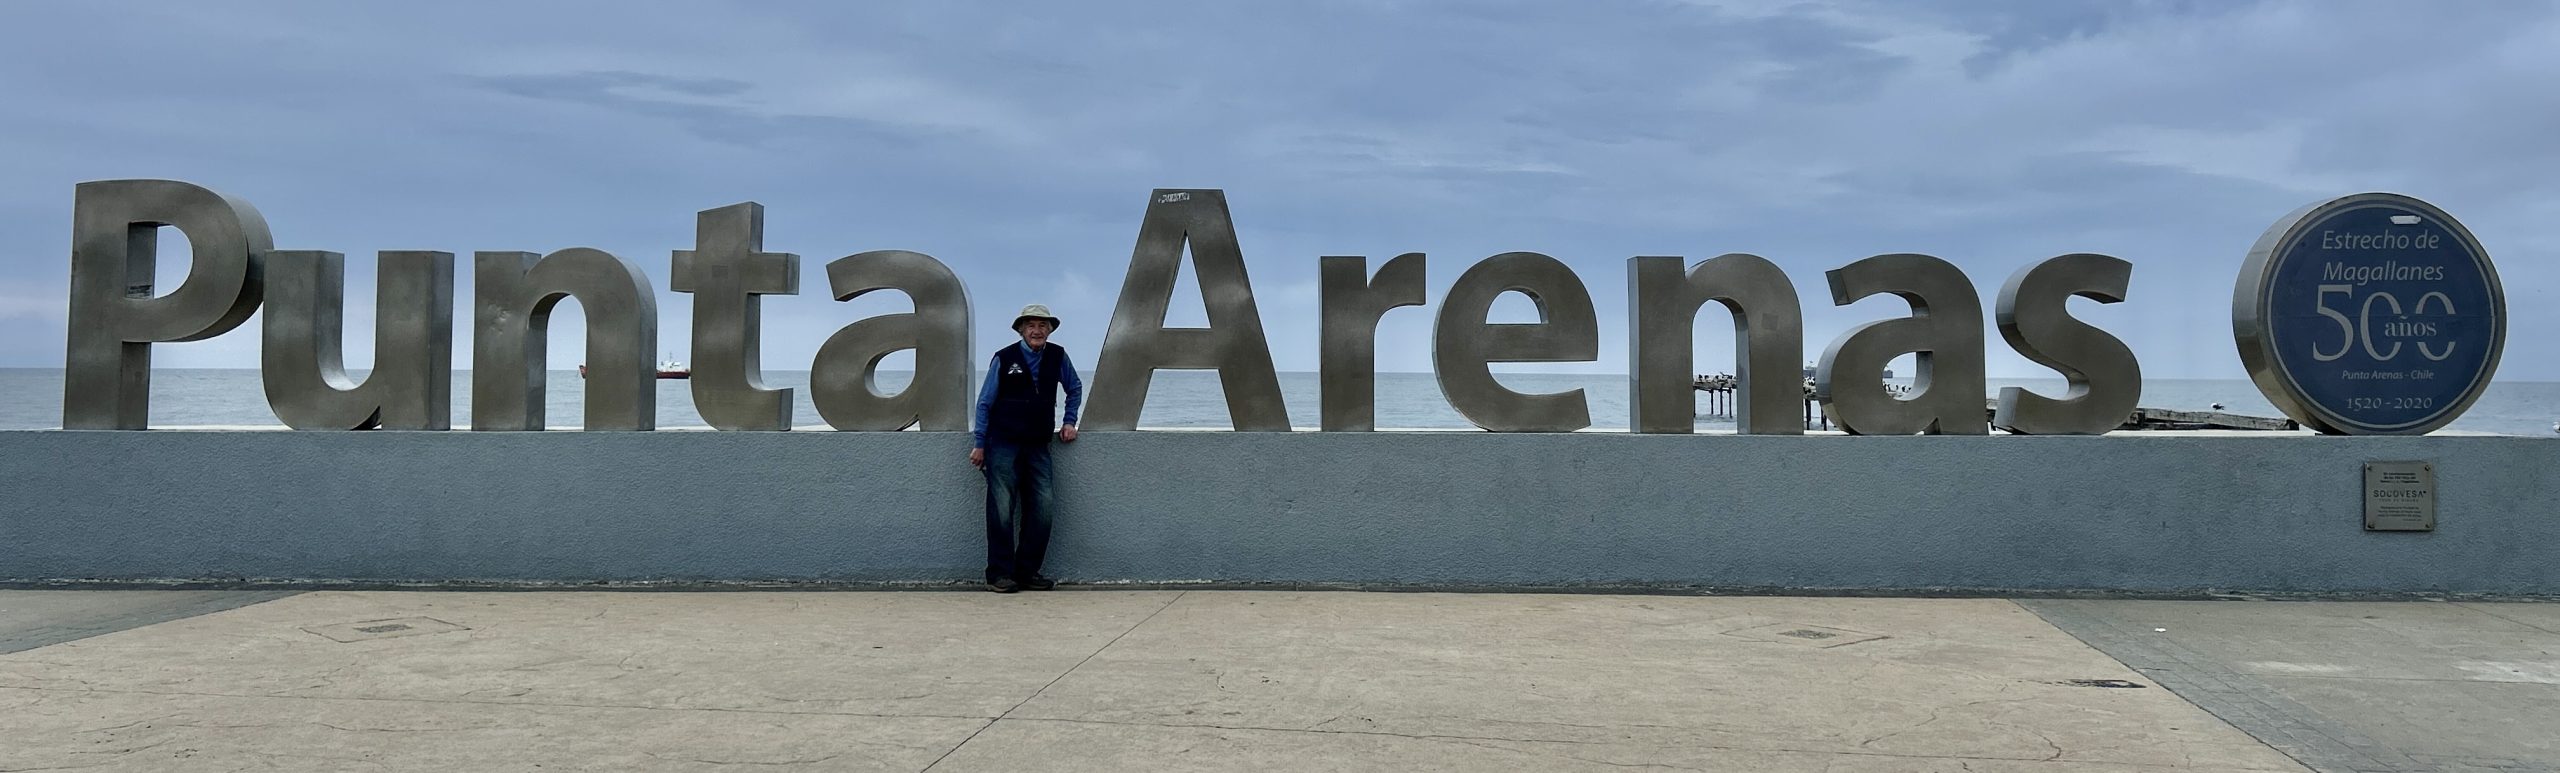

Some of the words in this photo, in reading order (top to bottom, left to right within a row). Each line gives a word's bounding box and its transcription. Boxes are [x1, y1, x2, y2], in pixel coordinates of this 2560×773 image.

[2322, 229, 2410, 250] Estrecho
[2414, 229, 2440, 249] de
[2323, 260, 2444, 286] Magallanes
[63, 178, 974, 432] Punta
[1079, 188, 2142, 435] Arenas
[2312, 284, 2456, 362] 500
[2384, 315, 2437, 338] años
[2342, 369, 2370, 380] Punta
[2371, 370, 2404, 380] Arenas
[2410, 369, 2435, 380] Chile
